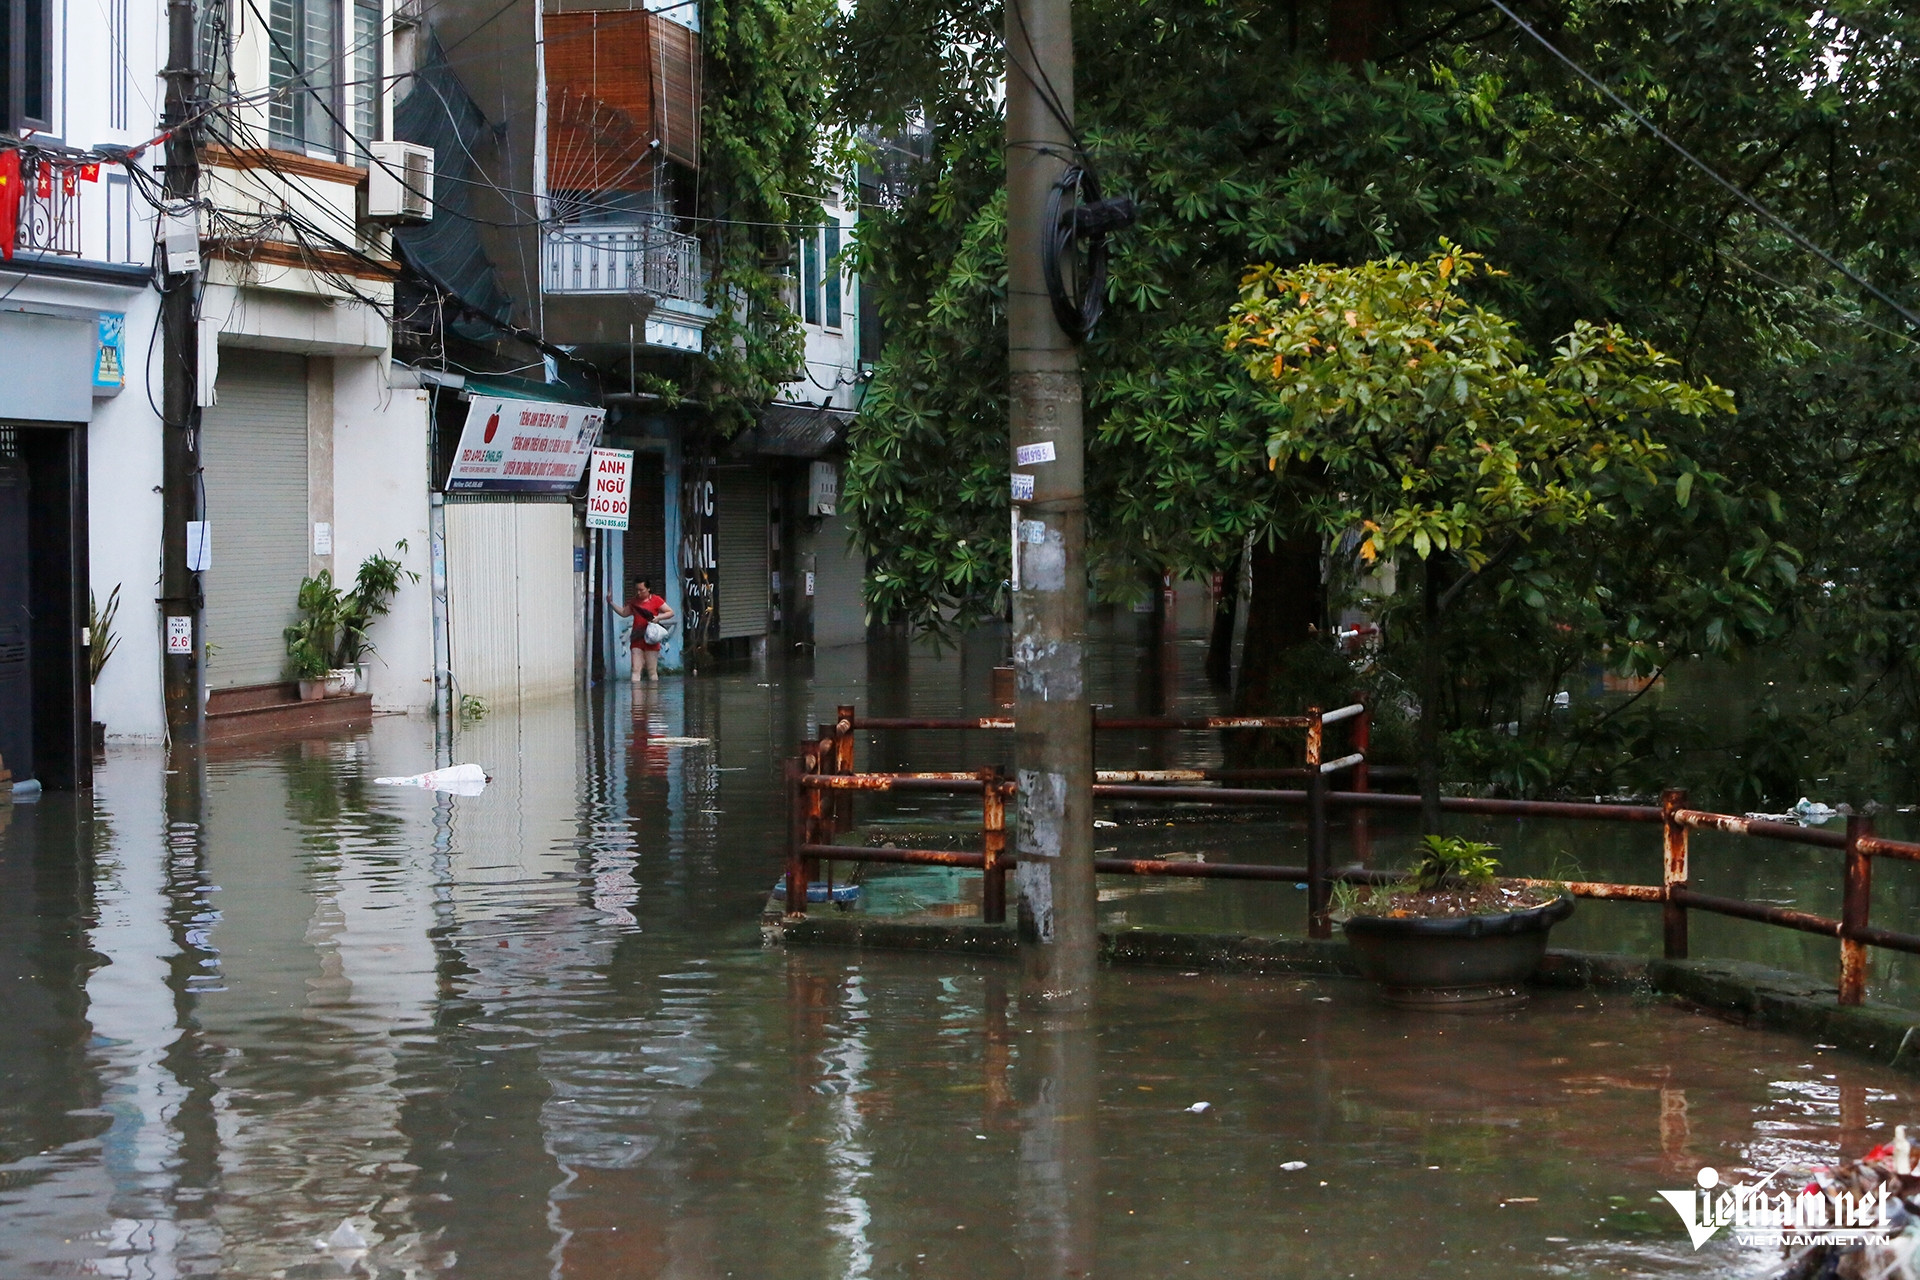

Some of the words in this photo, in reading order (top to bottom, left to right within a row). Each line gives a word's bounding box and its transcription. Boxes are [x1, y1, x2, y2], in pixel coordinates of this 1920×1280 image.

[462, 449, 472, 461] RED
[470, 450, 486, 462] APPLE
[598, 460, 625, 474] ANH
[597, 478, 625, 493] NGỮ
[590, 496, 610, 512] TÁO
[612, 497, 627, 514] ĐỎ
[684, 481, 713, 517] OC
[684, 534, 716, 569] NAIL
[171, 636, 187, 647] 2.6
